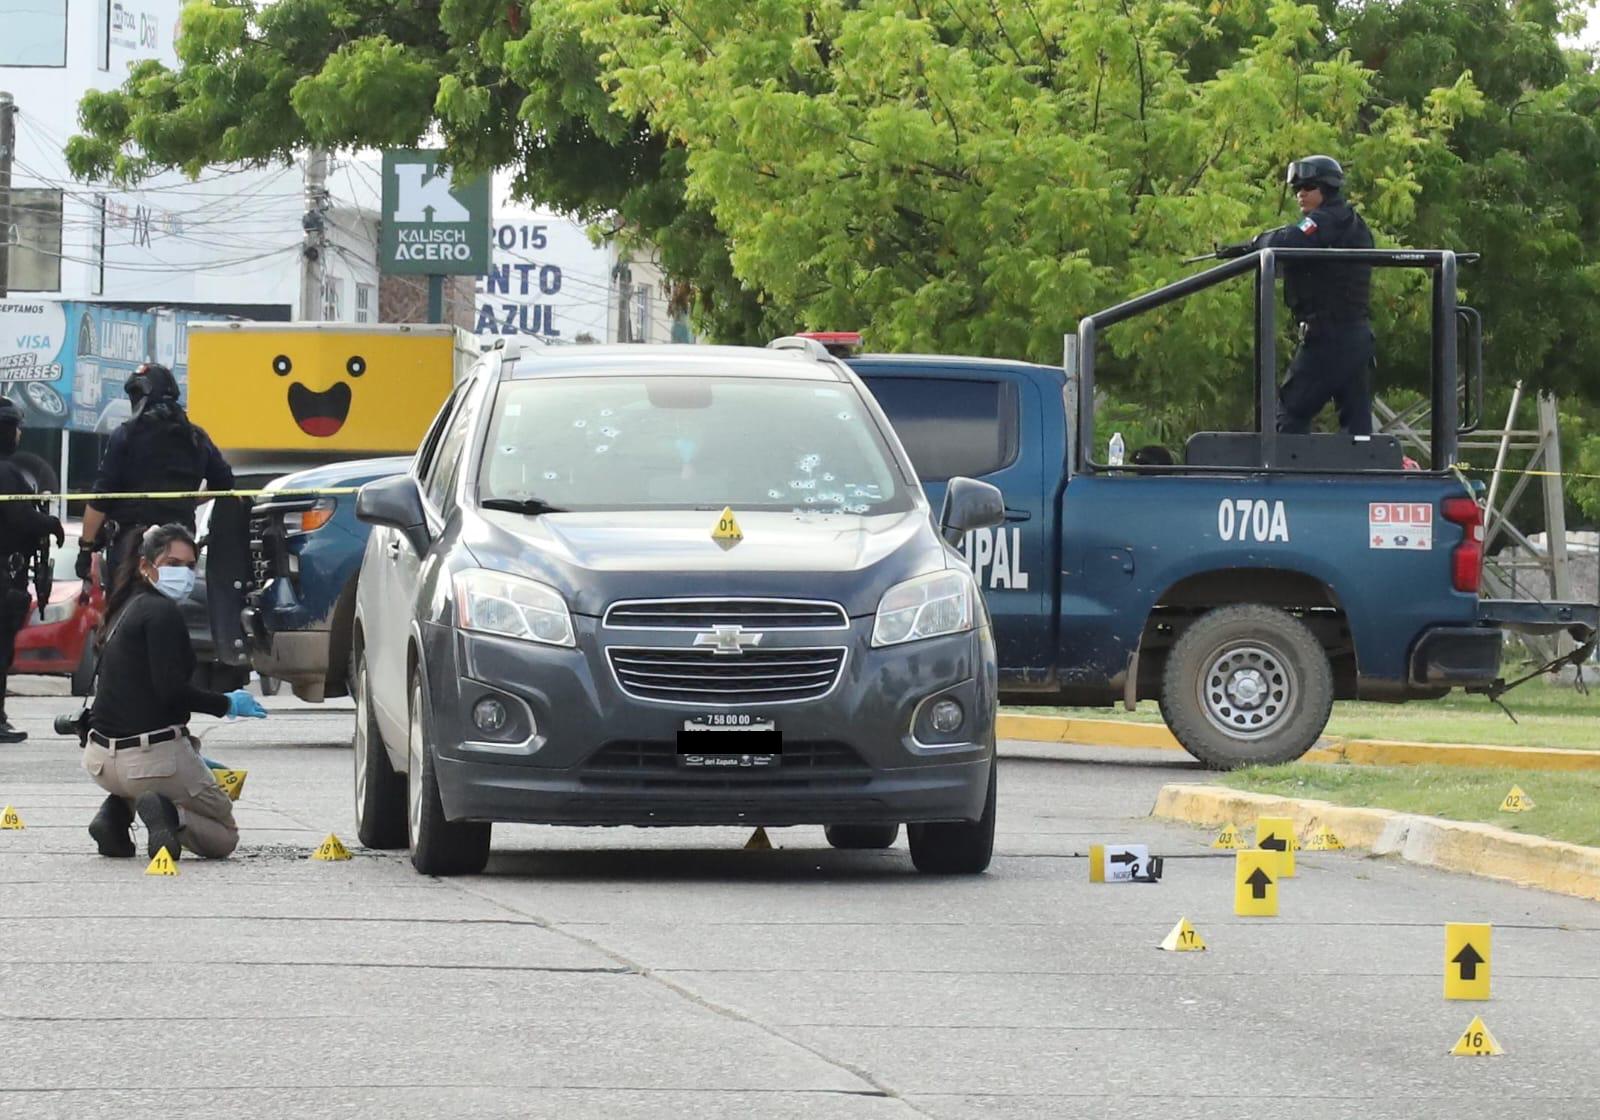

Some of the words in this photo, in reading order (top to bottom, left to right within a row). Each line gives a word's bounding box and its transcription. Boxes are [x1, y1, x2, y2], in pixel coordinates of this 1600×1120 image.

[399, 229, 466, 243] KALISCH
[394, 243, 471, 260] ACERO
[0, 304, 44, 314] EPTAMOS
[474, 304, 560, 336] AZUL
[16, 336, 50, 349] VISA
[1218, 498, 1290, 542] 070A
[1374, 506, 1426, 521] 911
[720, 518, 735, 532] 01
[958, 527, 1029, 589] IPAL
[223, 771, 238, 785] 19
[1506, 795, 1520, 807] 02
[5, 814, 18, 825] 09
[1219, 832, 1232, 844] 03
[155, 858, 168, 870] 11
[1180, 930, 1195, 945] 17
[1463, 1031, 1484, 1048] 16
